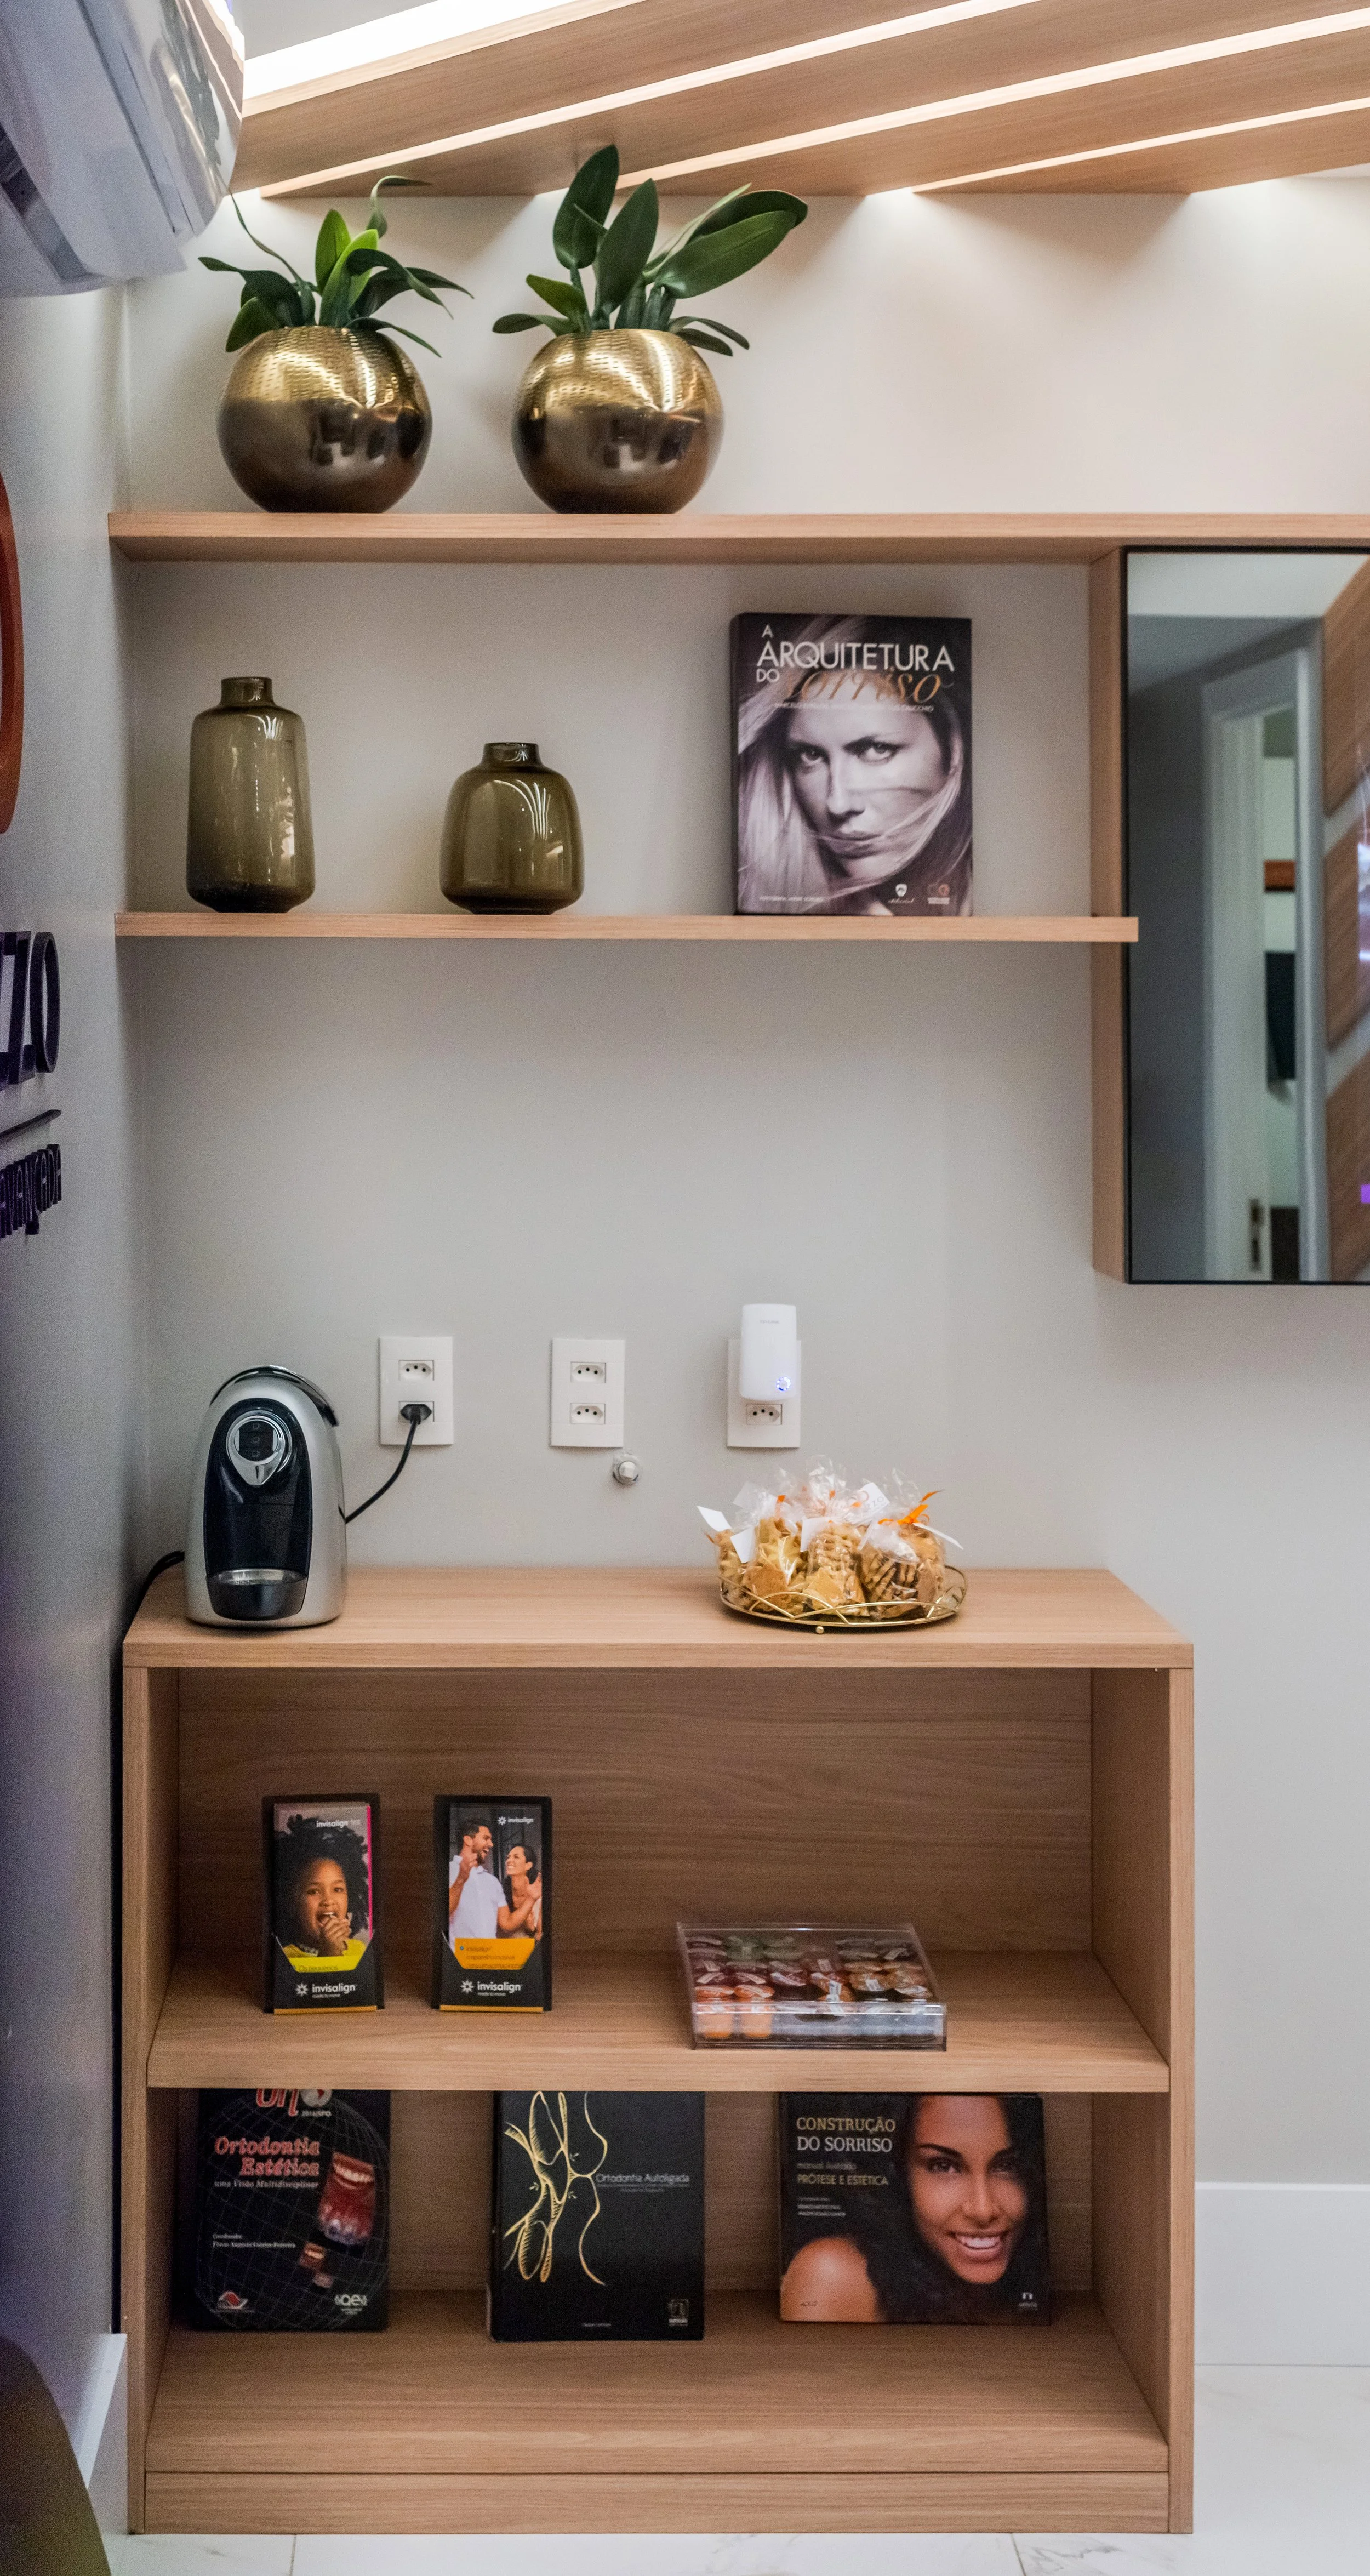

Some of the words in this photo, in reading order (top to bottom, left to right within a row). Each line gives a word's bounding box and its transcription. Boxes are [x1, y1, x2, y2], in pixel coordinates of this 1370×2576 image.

[761, 624, 774, 638] A
[756, 641, 955, 672] ARQUITETURA
[756, 668, 780, 683] DO
[316, 1820, 349, 1828] invisalign
[312, 1982, 356, 1994] invisalign
[477, 1981, 521, 1993] invisalign
[796, 2116, 896, 2135] CONSTRUÇÃO
[214, 2136, 321, 2156] Ortodontia
[797, 2136, 820, 2151] DO
[824, 2136, 893, 2153] SORRISO
[239, 2157, 320, 2176] Estética
[596, 2173, 642, 2183] Ortodontia
[644, 2173, 690, 2186] Autoligada
[797, 2173, 837, 2185] PRÓTESE
[838, 2175, 845, 2185] E
[847, 2174, 889, 2186] ESTÉTICA
